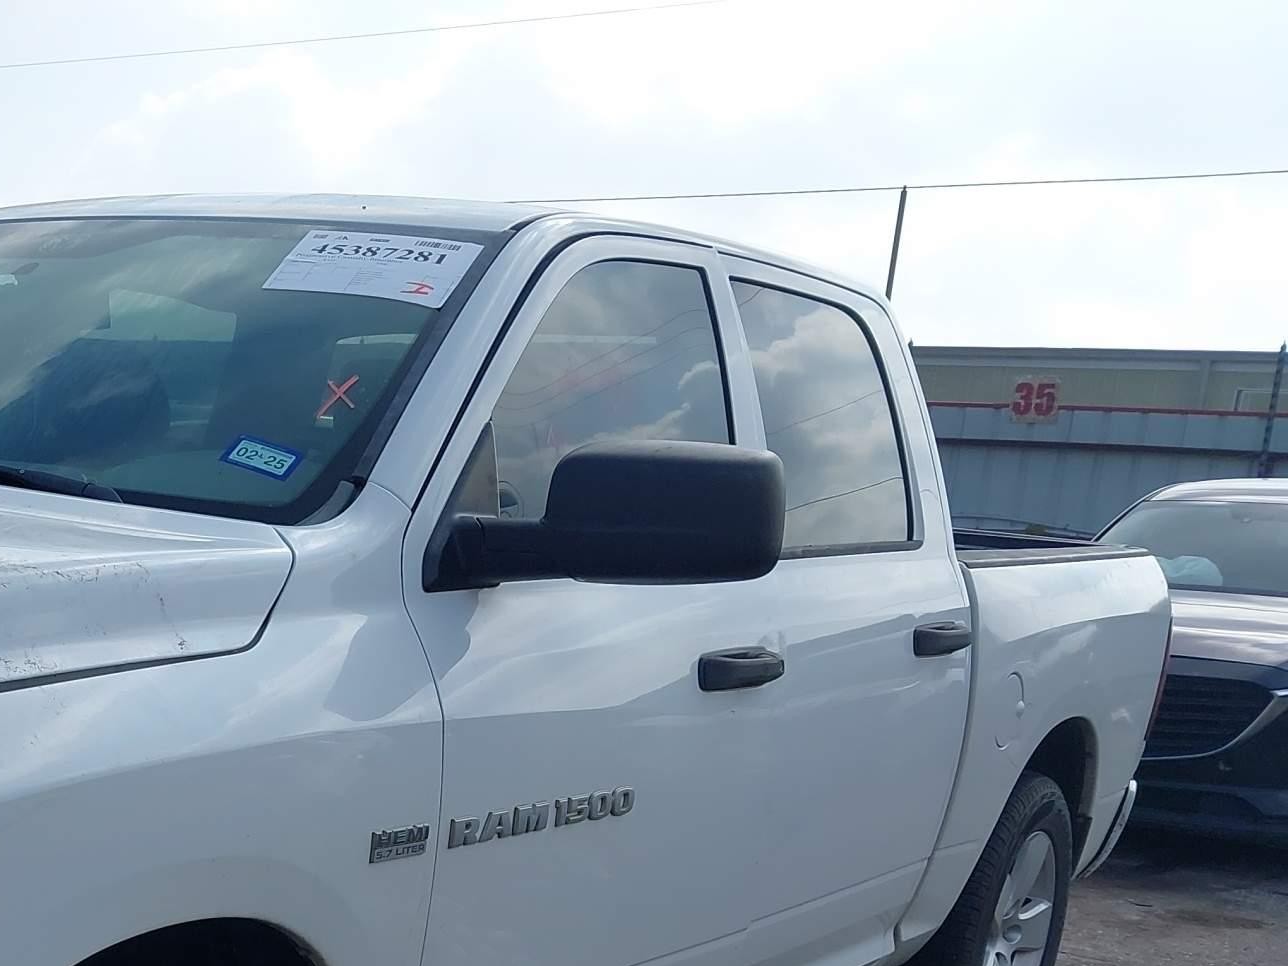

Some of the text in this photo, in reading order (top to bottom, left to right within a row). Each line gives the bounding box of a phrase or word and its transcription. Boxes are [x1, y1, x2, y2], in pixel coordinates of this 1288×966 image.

[311, 243, 448, 265] 45387281
[1012, 382, 1057, 416] 35
[448, 785, 636, 849] RAM 1500
[369, 824, 430, 848] HEMI
[376, 843, 425, 860] 5.7 LITER
